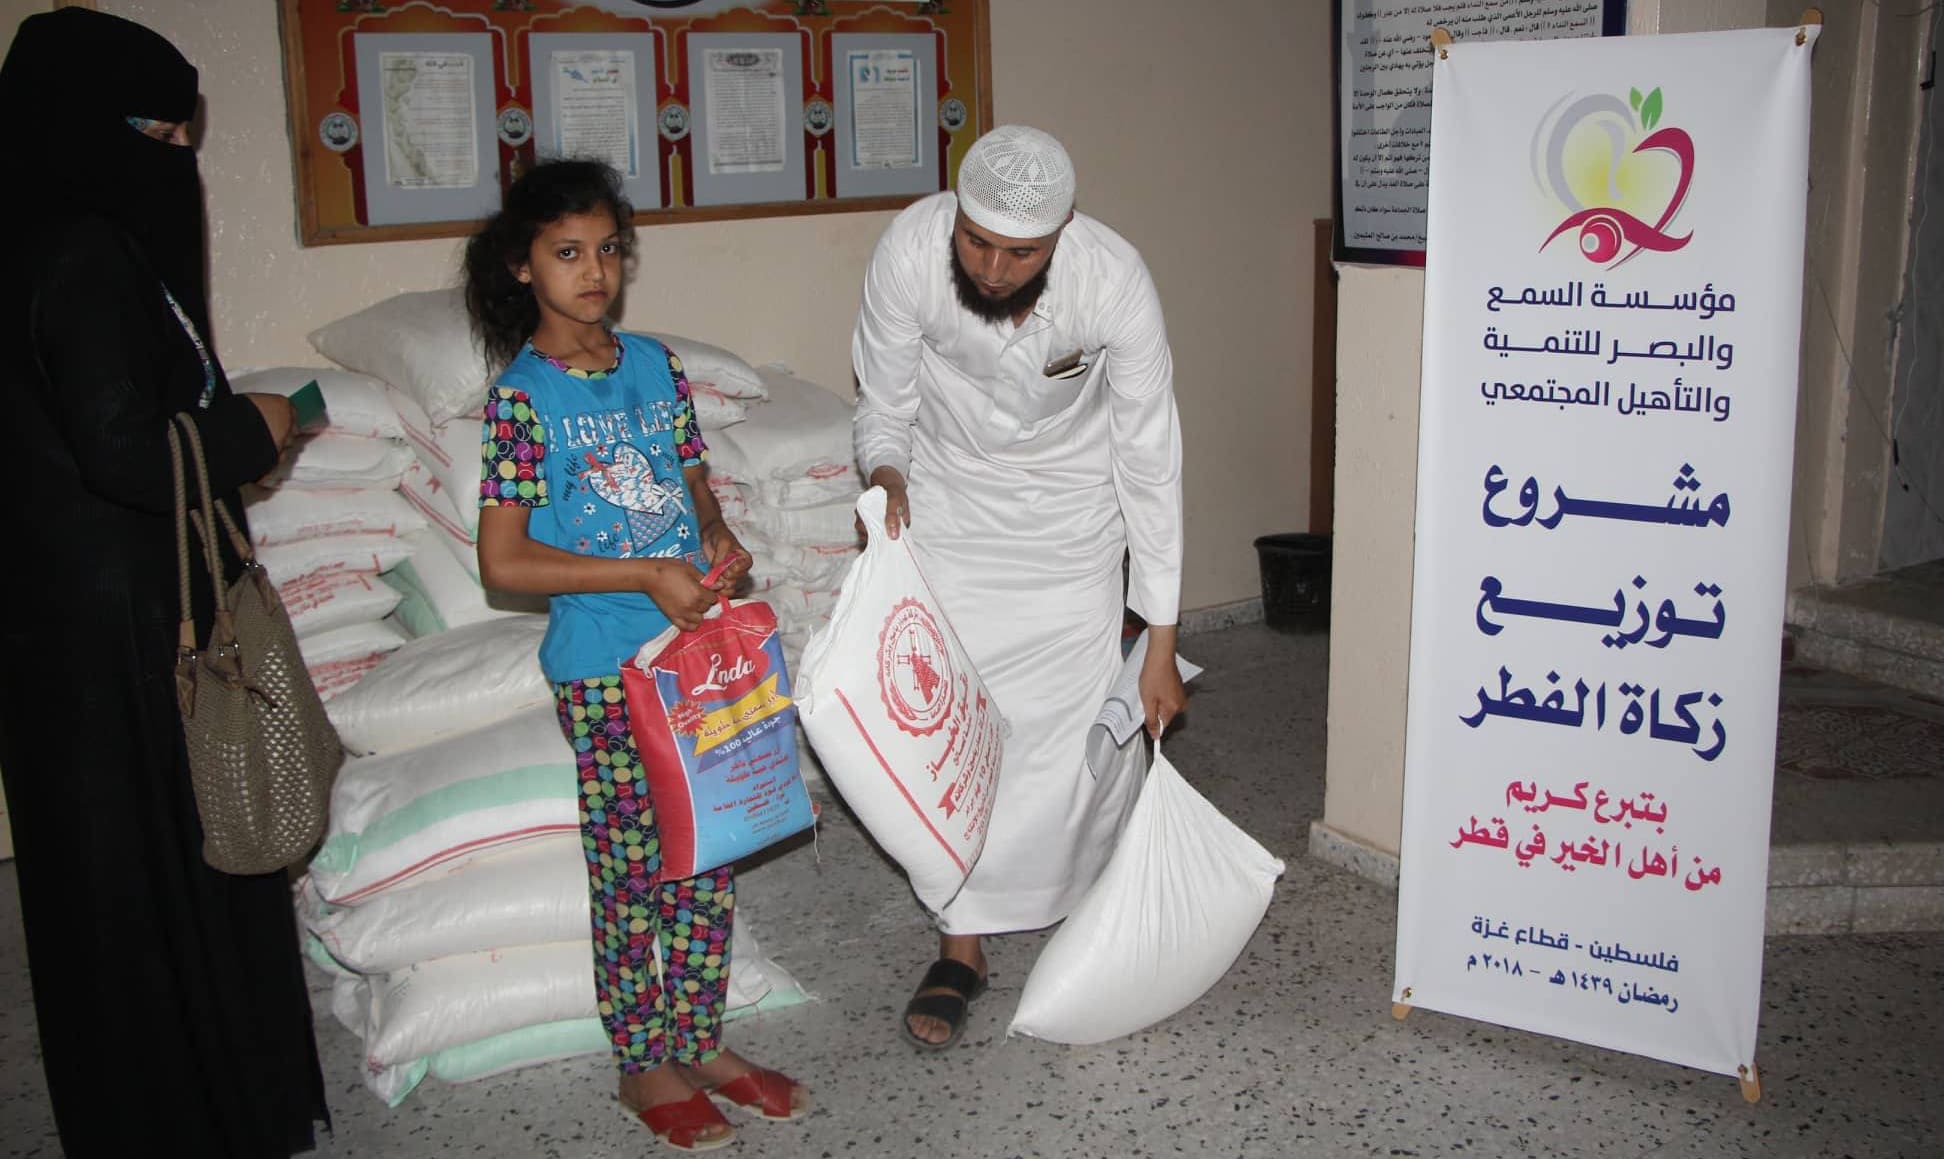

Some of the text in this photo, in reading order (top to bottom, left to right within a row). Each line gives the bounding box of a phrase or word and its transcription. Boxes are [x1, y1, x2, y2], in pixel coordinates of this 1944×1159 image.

[1487, 281, 1735, 320] مؤسسة السمع
[1484, 327, 1733, 370] والبصر للتنمية
[1481, 378, 1730, 422] والتأهيل المجتمعي
[562, 411, 633, 449] LOVE
[1483, 463, 1731, 530] مشروع
[1476, 575, 1726, 650] توزيع
[1459, 665, 1726, 761] زكاة الفطر
[1506, 781, 1667, 834] بتبرع كريم
[1450, 816, 1721, 891] من أهل الخير في قطر
[1472, 916, 1509, 939] غزة
[1515, 927, 1568, 950] قطاع
[1467, 955, 1477, 971] م
[1483, 954, 1522, 976] ٢٠١٨
[1589, 940, 1679, 973] فلسطين
[1572, 971, 1612, 995] ١٤٣٩
[1618, 983, 1678, 1013] رمضان
